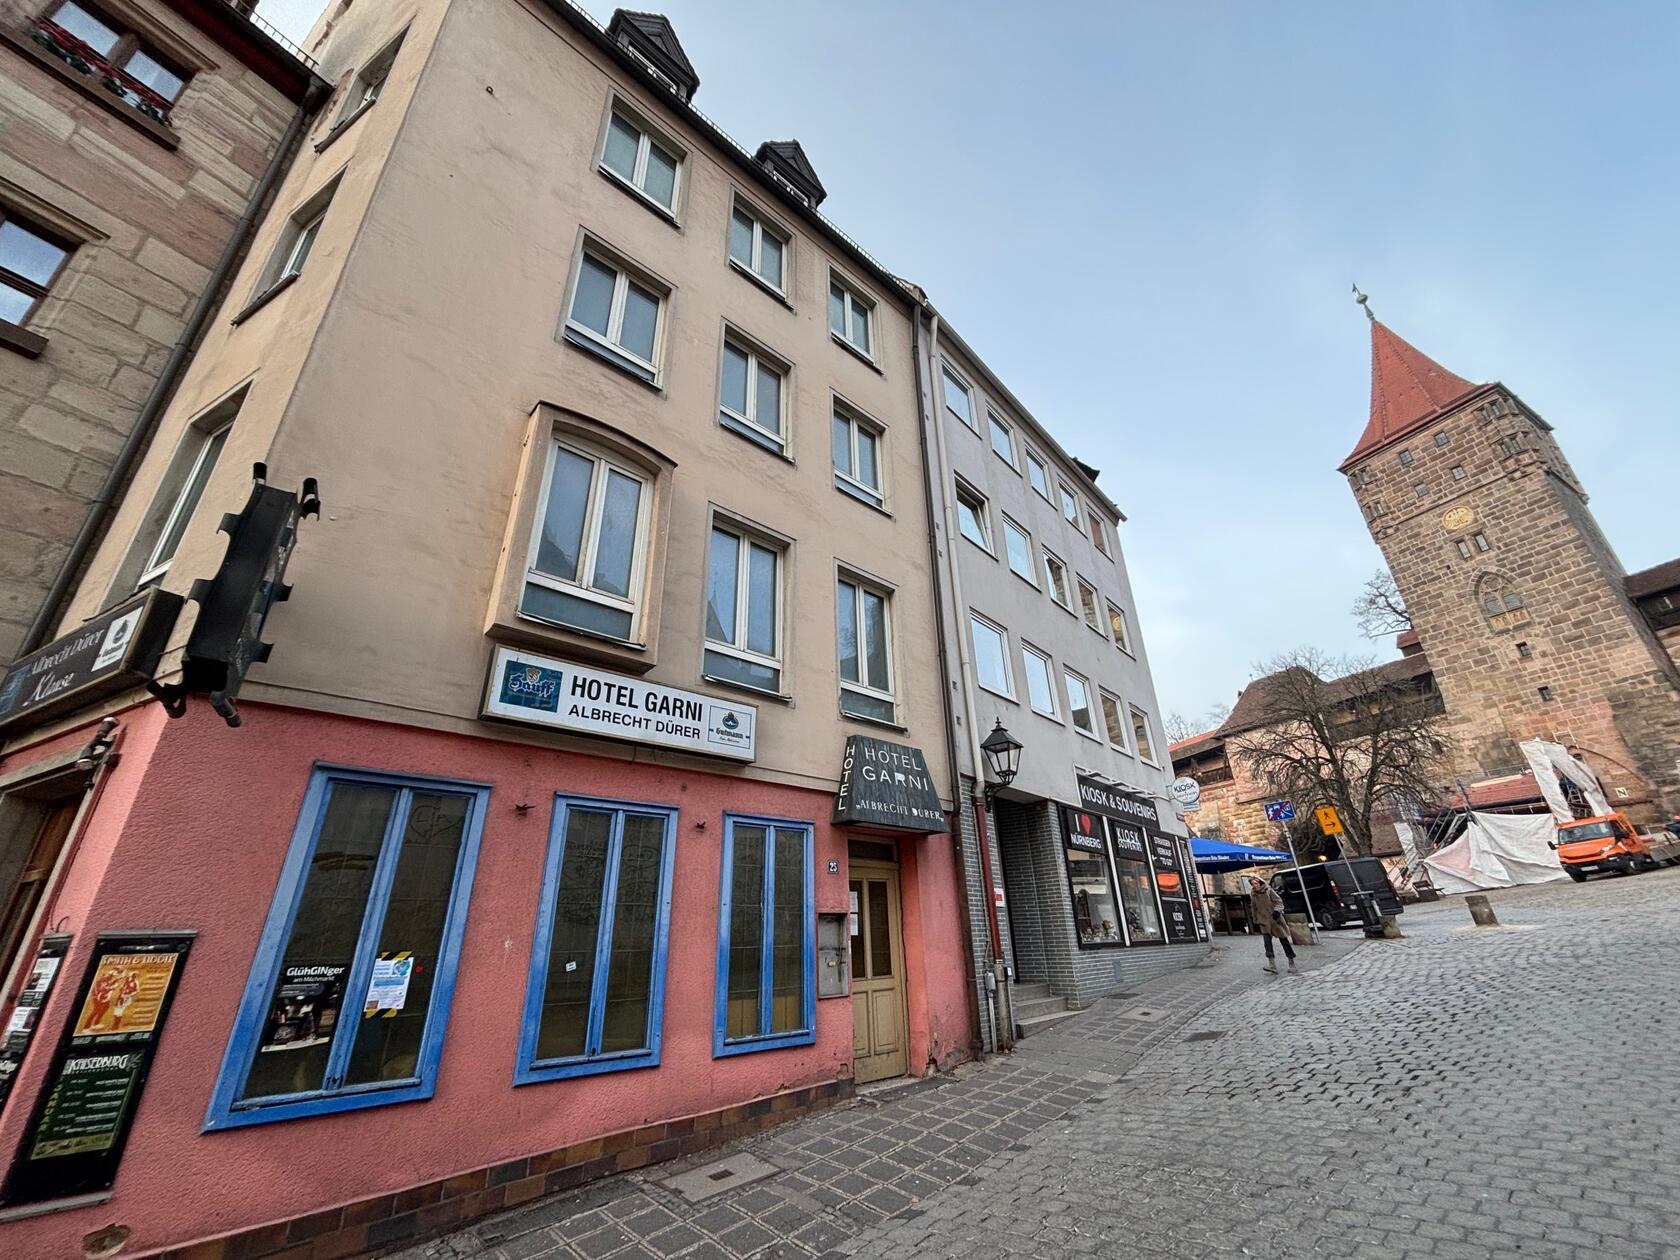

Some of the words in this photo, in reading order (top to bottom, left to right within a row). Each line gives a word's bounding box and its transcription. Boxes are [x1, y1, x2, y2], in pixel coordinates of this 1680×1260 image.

[571, 675, 638, 709] HOTEL
[645, 692, 702, 722] GARNI
[568, 704, 652, 730] ALBRECHT
[656, 720, 701, 739] DÜRER
[865, 747, 921, 771] HOTEL
[838, 745, 855, 811] HOTEL
[862, 766, 929, 791] GARNI
[1174, 781, 1196, 793] KIOSK
[1080, 784, 1109, 807] KIOSK
[1109, 794, 1116, 808] &
[1116, 796, 1157, 820] SOUVENIRS
[1075, 813, 1081, 832] I
[1071, 833, 1101, 849] NÜRNBERG
[1116, 827, 1139, 843] KIOSK
[286, 966, 345, 976] GlühGINger
[67, 1055, 128, 1074] KAISERBURG
